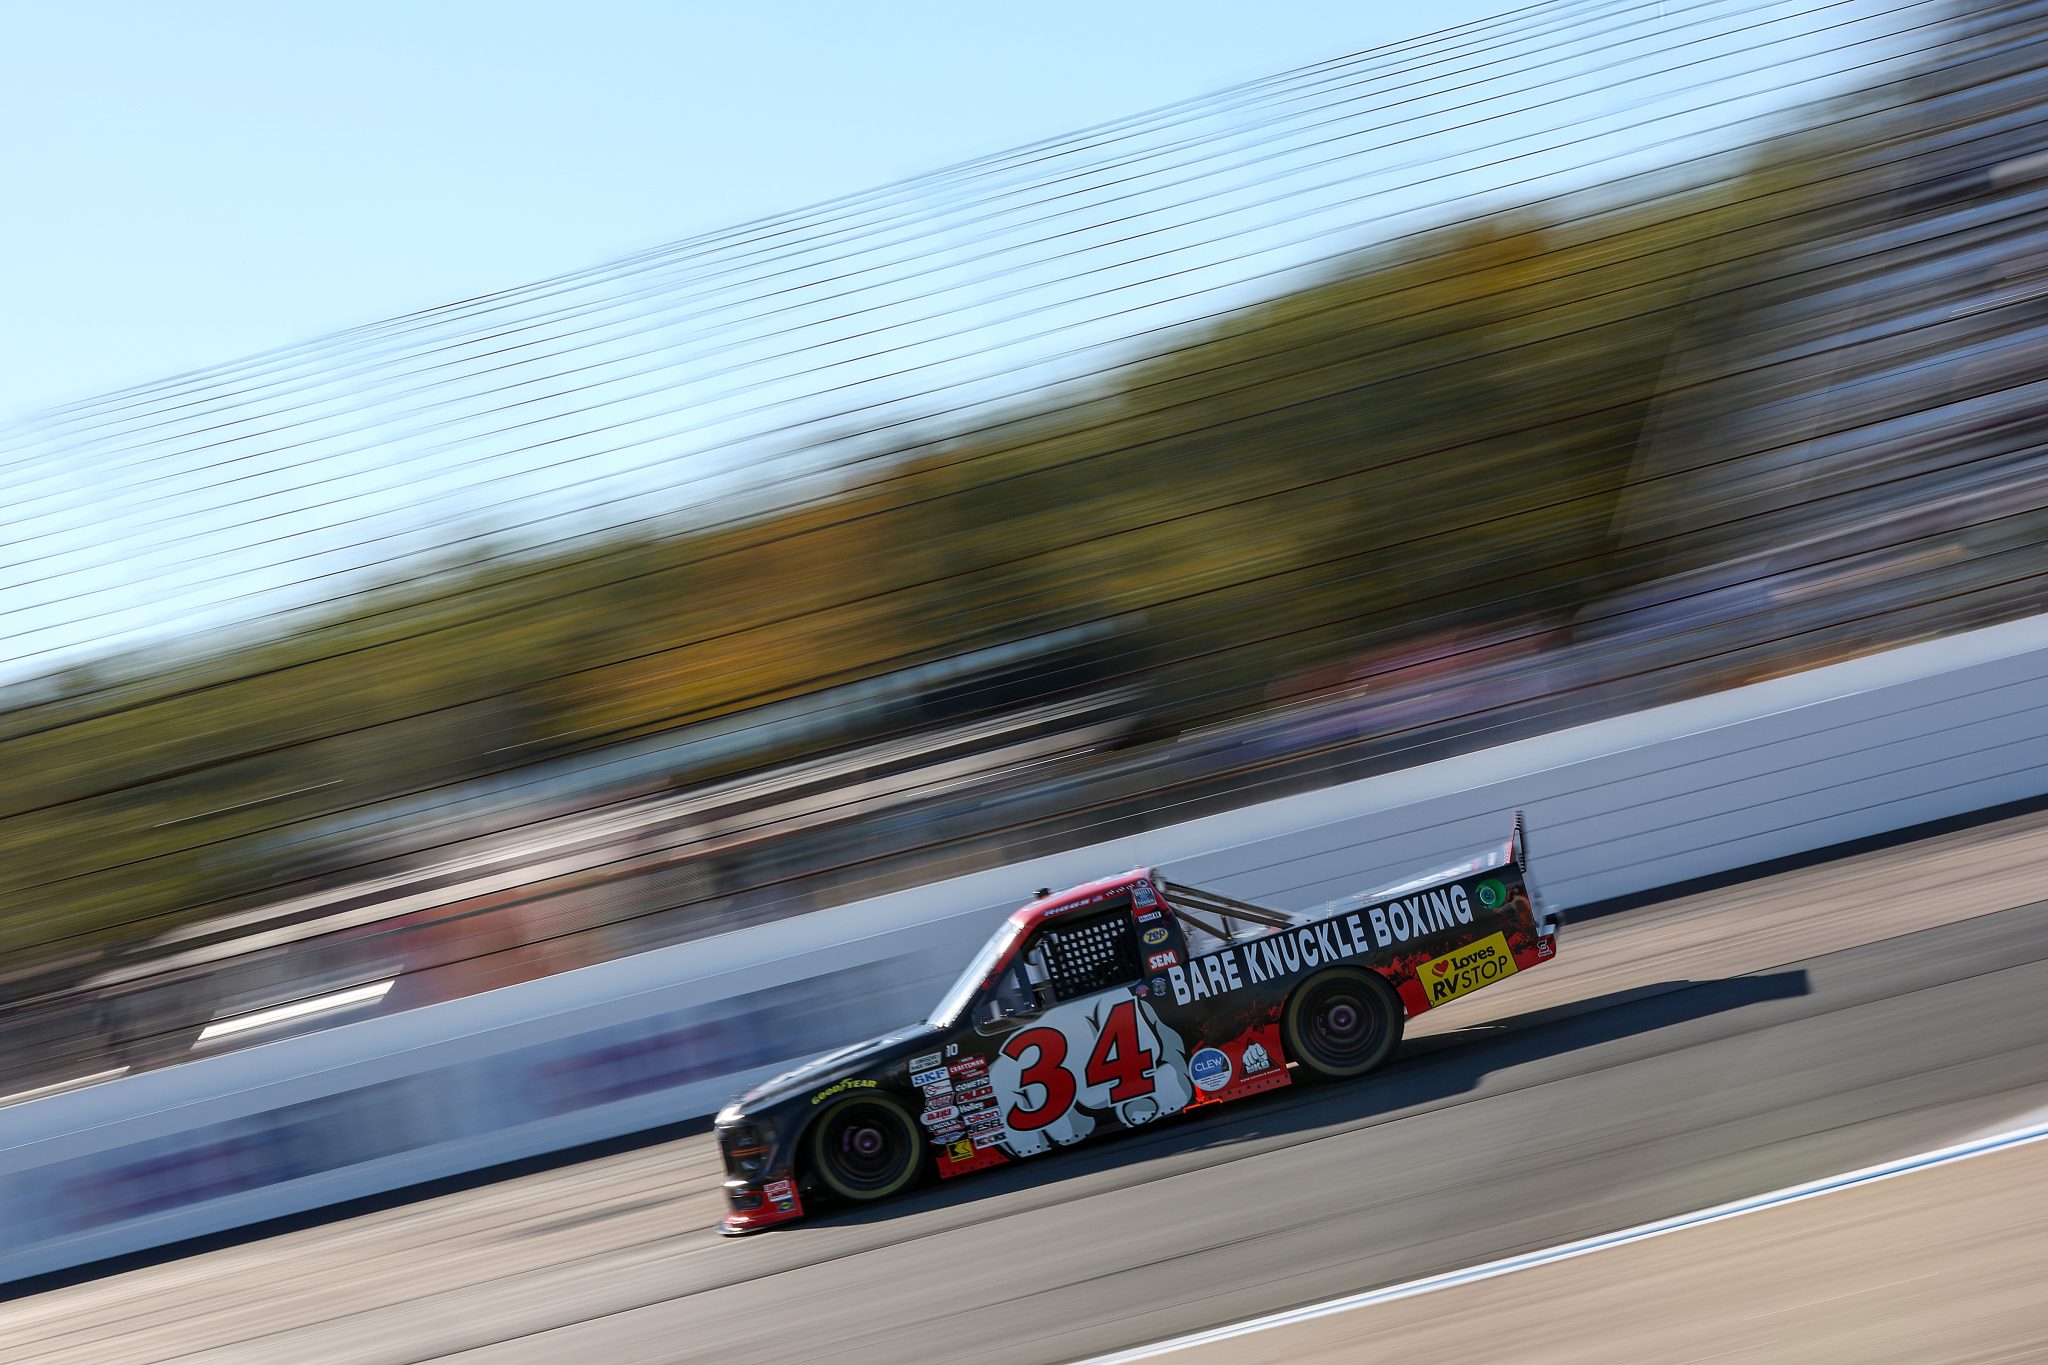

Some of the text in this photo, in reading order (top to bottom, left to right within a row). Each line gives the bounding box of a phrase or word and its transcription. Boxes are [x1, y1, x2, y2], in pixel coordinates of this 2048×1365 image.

[1146, 929, 1166, 943] zep
[1168, 884, 1474, 1006] BARE KNUCKLE BOXING
[1149, 952, 1177, 969] SEM
[945, 1043, 958, 1057] 10
[1000, 997, 1156, 1132] 34
[1195, 1057, 1222, 1072] CLEW
[914, 1069, 946, 1085] SKF
[811, 1078, 878, 1105] GOODYEAR
